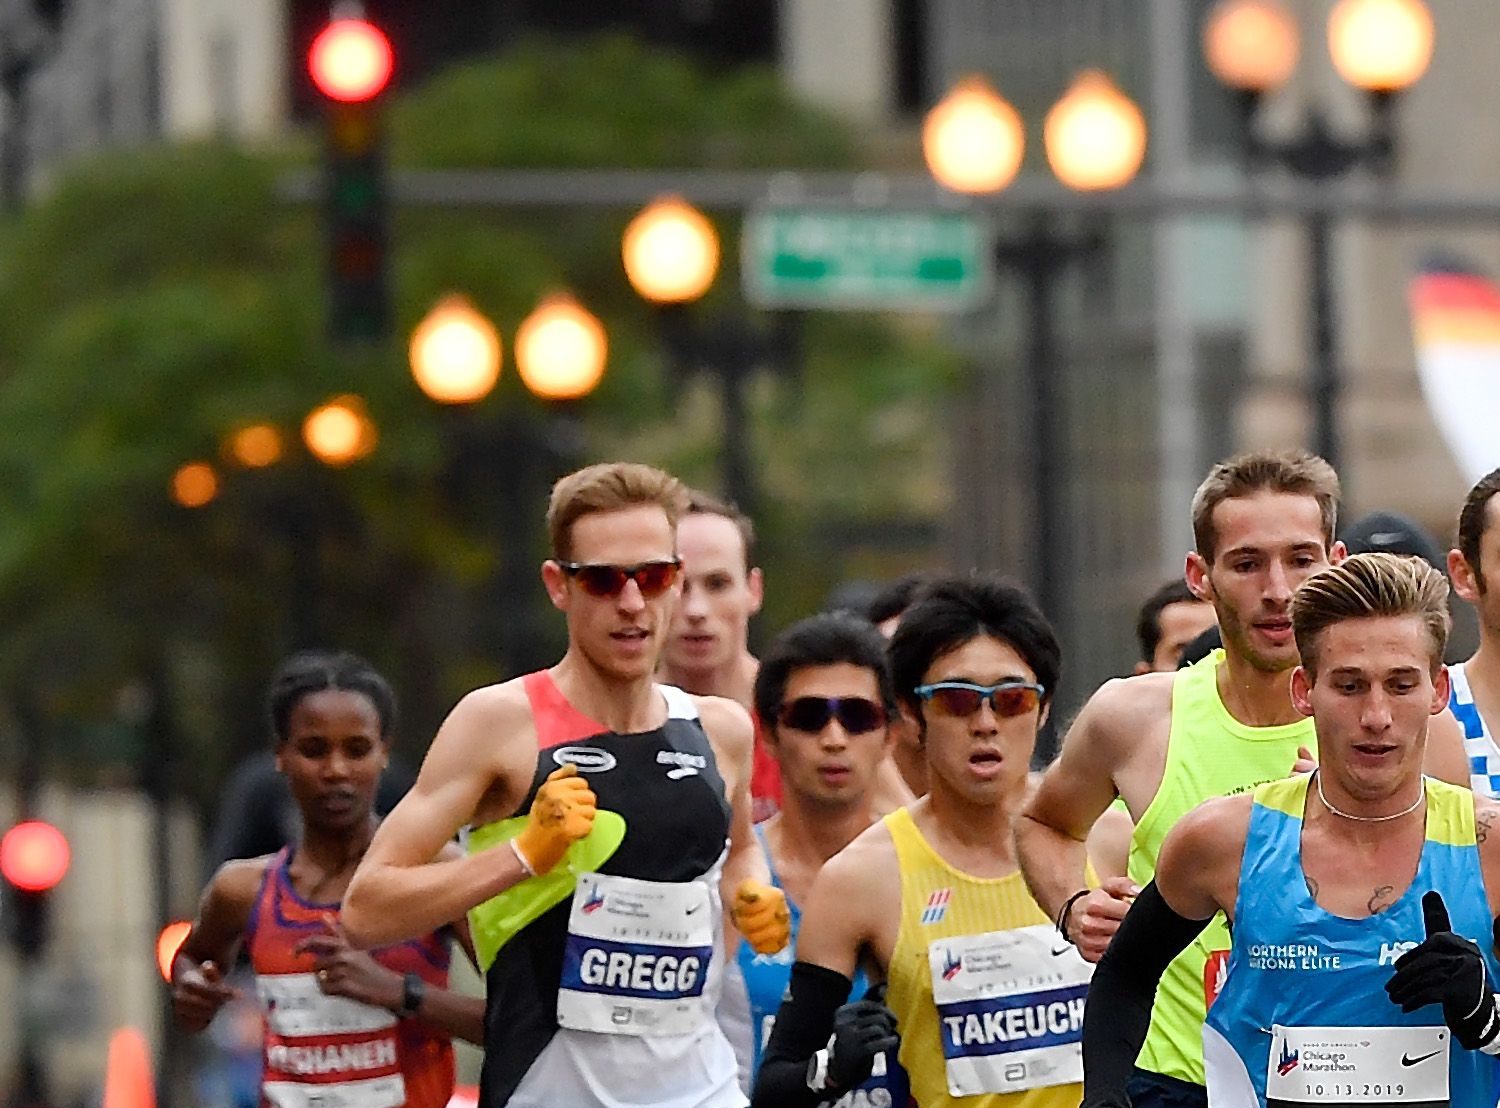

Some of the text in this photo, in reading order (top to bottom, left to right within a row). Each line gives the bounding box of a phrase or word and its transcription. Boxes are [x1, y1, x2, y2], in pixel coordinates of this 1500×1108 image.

[1302, 956, 1341, 969] ELITE
[580, 948, 700, 993] GREGG
[943, 998, 1087, 1047] TAKEUCH
[1303, 1050, 1345, 1064] Chicago
[1303, 1062, 1356, 1072] Marathon
[1306, 1084, 1404, 1095] 10.13.2019
